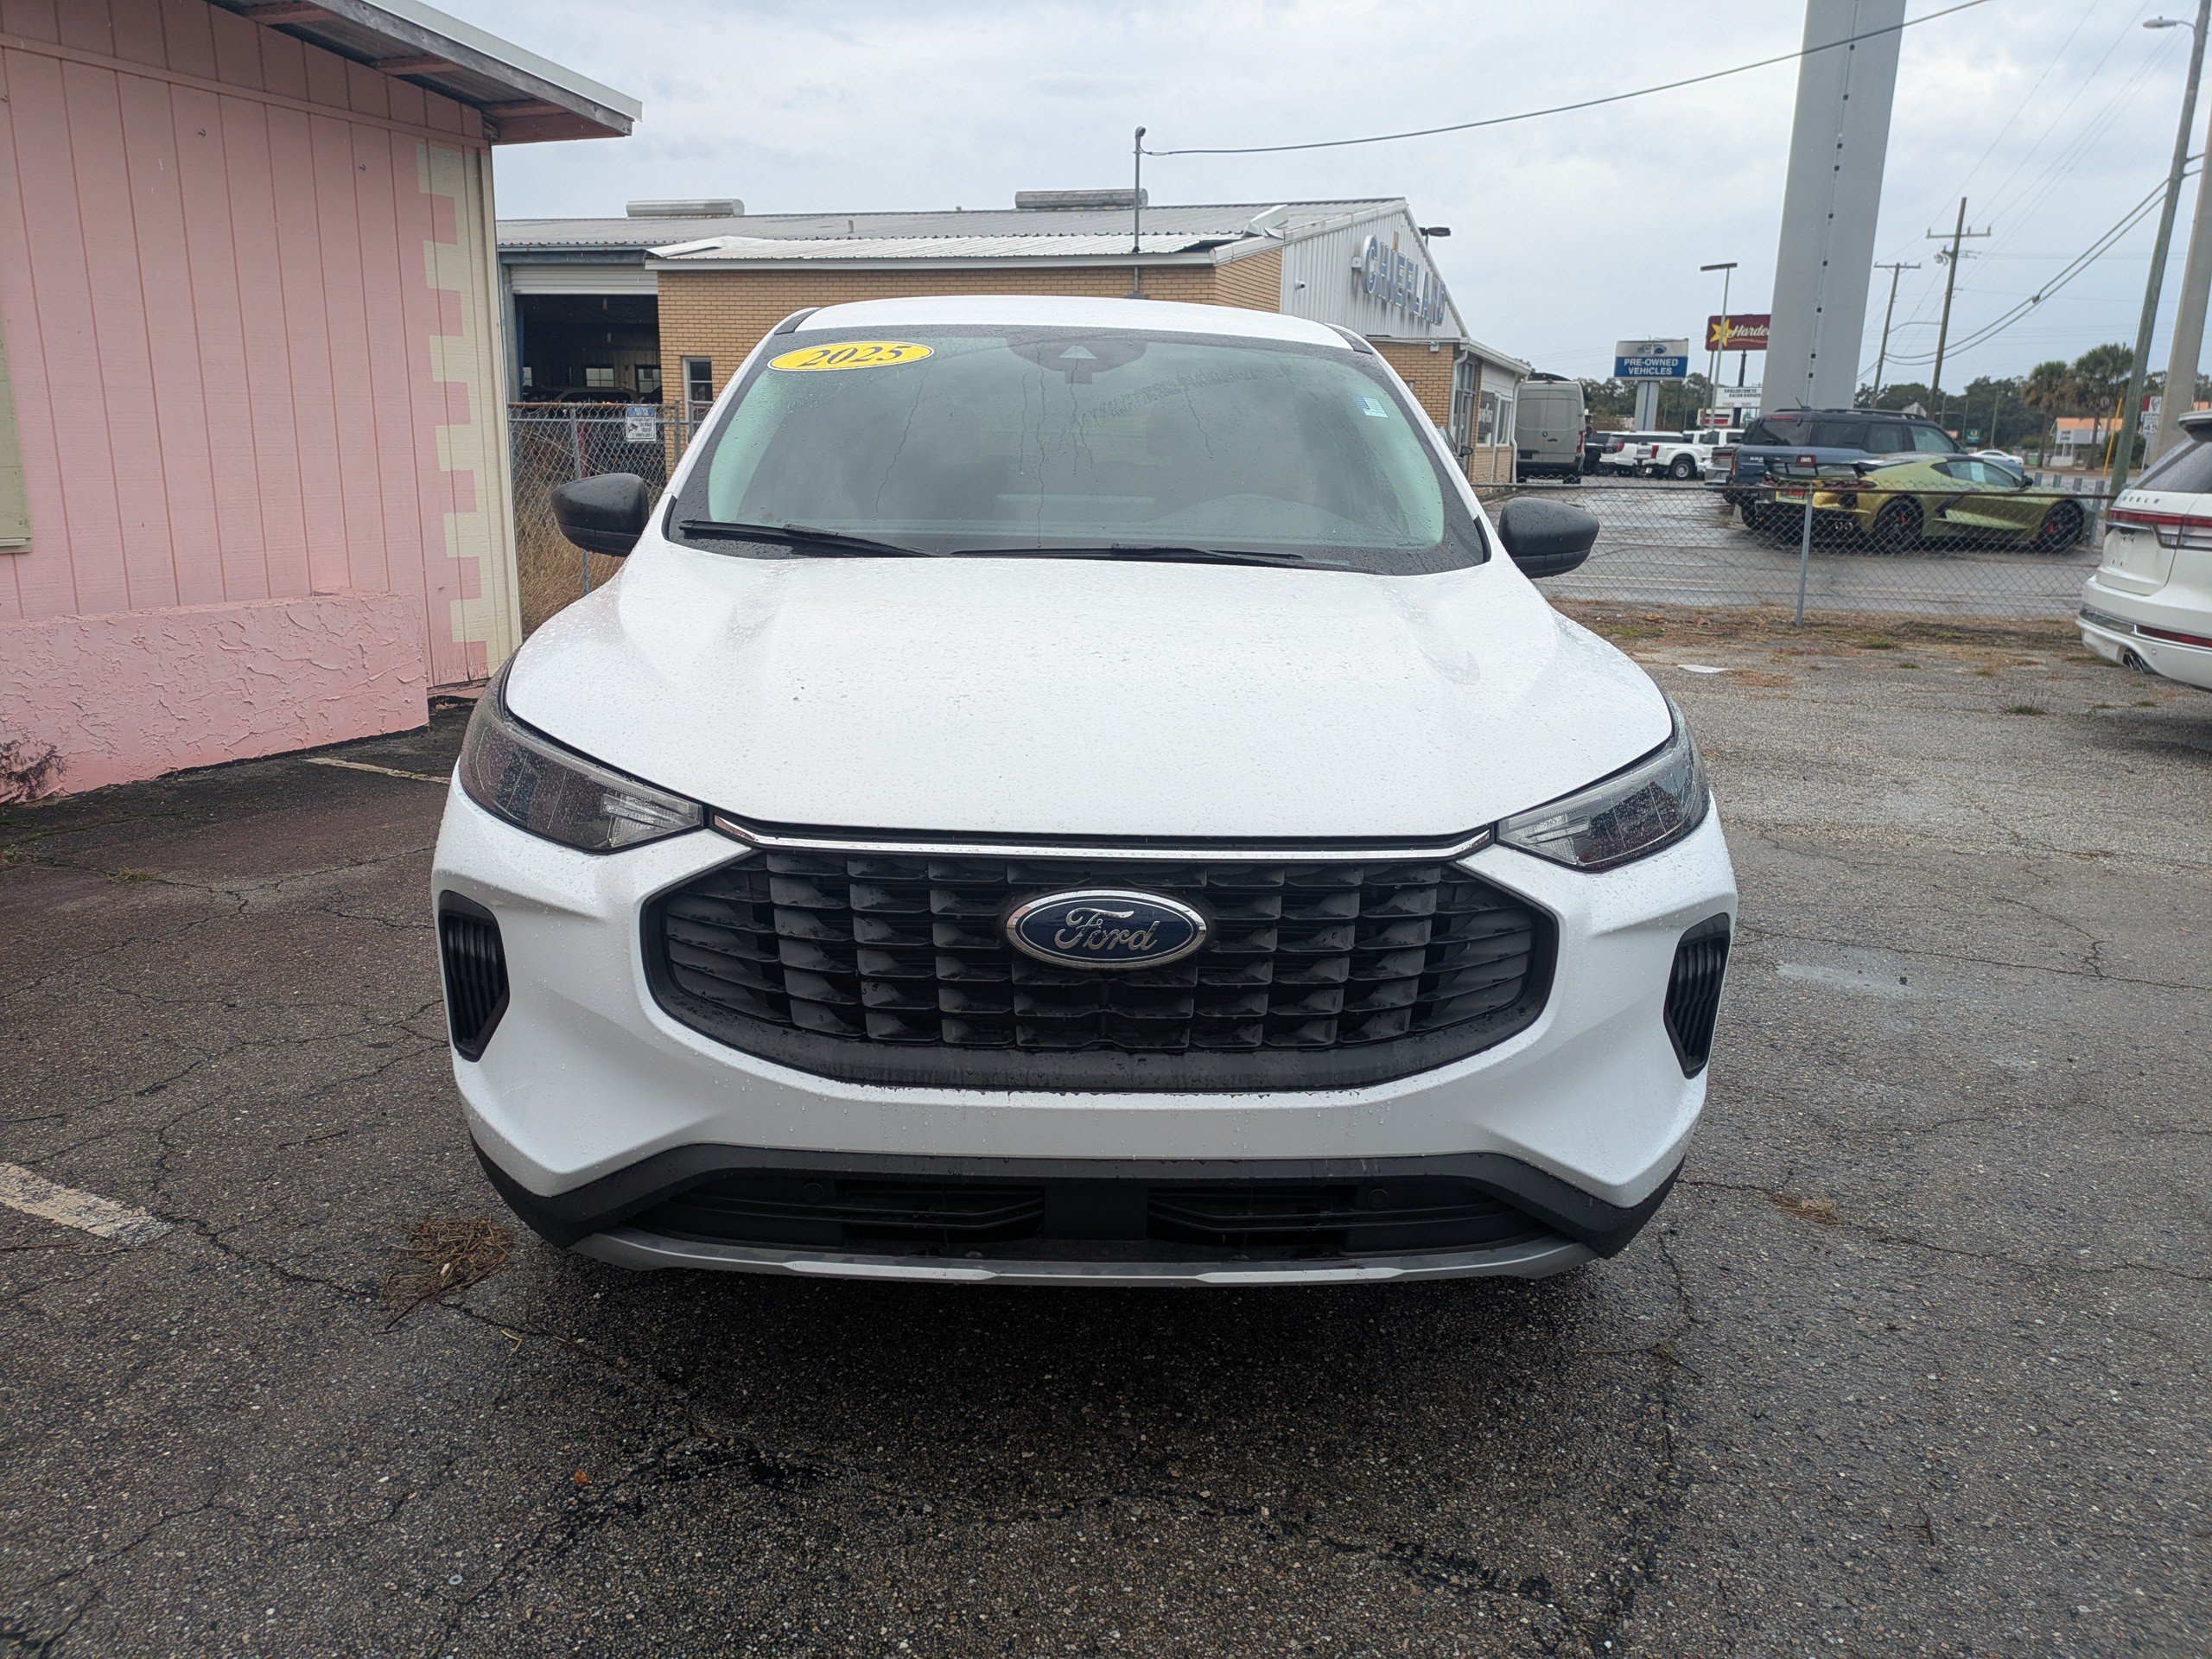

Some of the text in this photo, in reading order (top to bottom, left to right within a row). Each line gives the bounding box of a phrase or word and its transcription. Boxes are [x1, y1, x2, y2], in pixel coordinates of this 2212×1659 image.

[1364, 234, 1446, 327] CHIEFLAND
[797, 346, 912, 367] 2025
[1624, 358, 1679, 366] PRE-OWNED
[1628, 367, 1673, 376] VEHICLES
[1054, 907, 1160, 950] Ford
